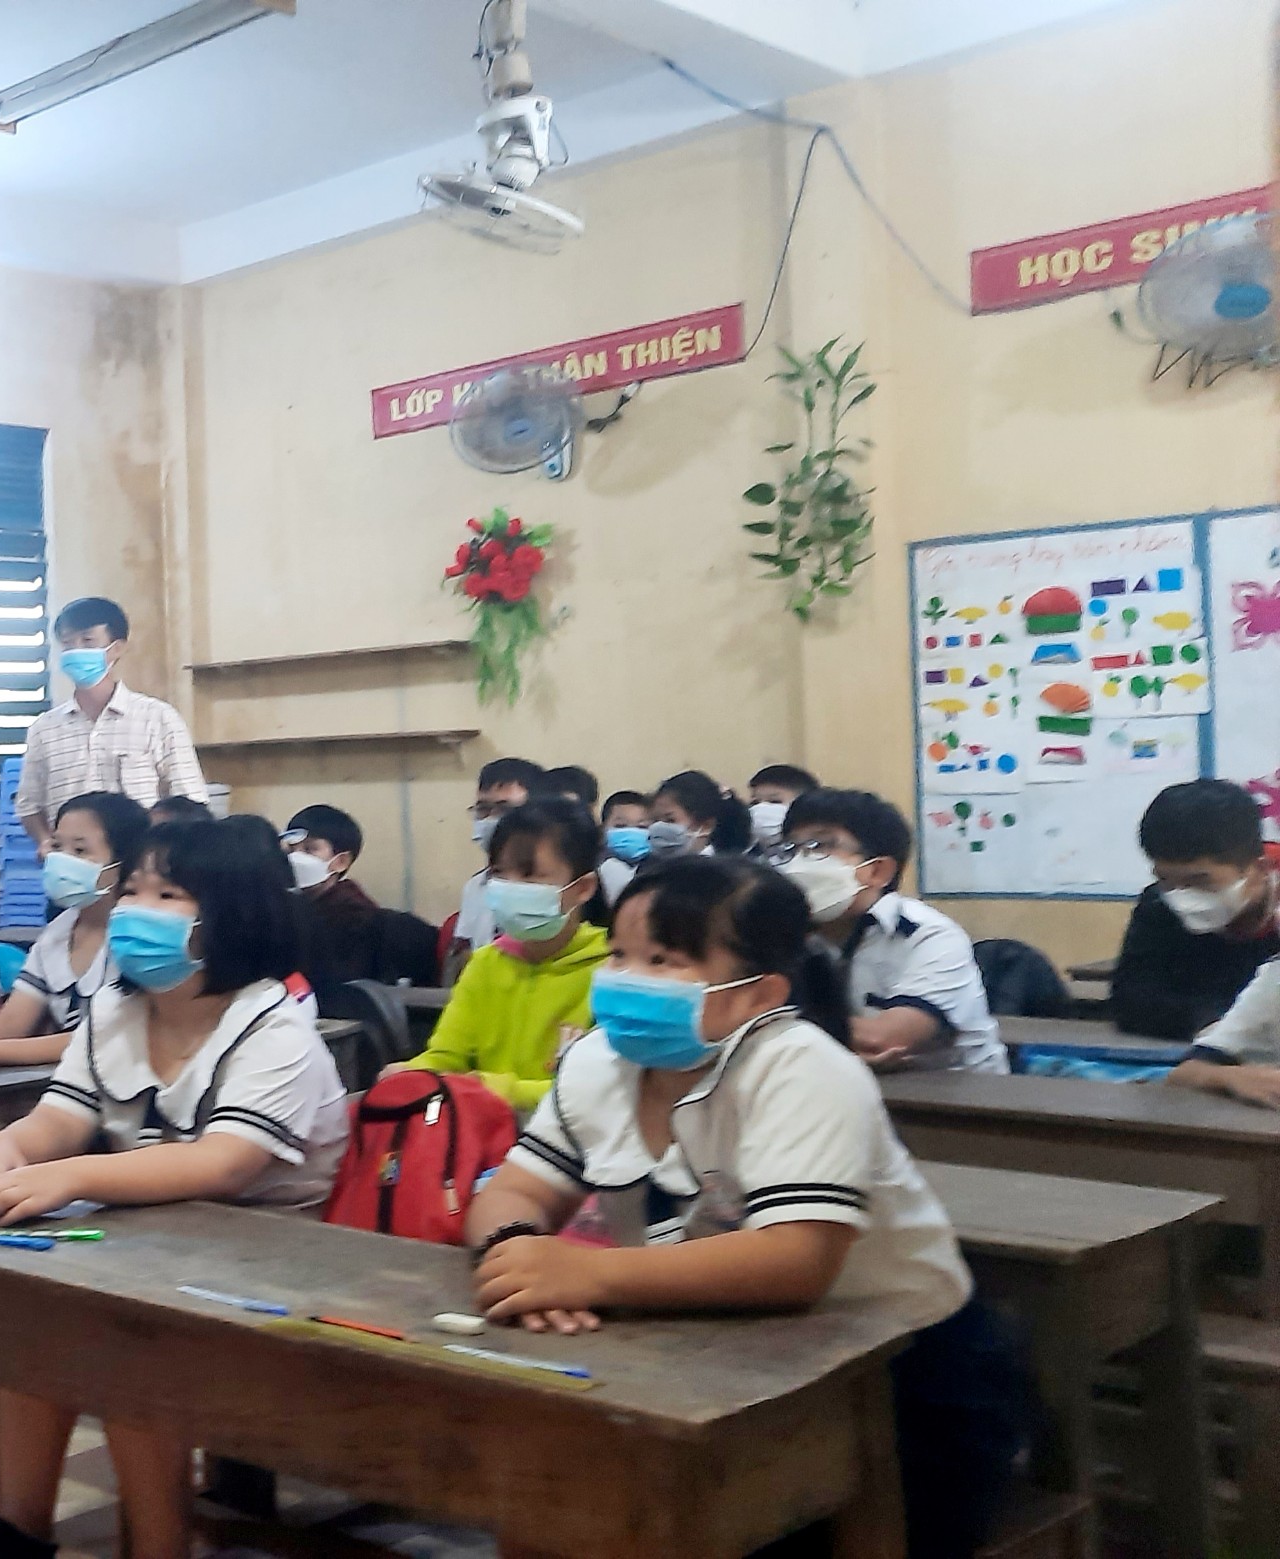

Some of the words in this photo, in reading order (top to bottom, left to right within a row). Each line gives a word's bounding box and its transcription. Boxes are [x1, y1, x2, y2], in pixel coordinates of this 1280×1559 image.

[1018, 240, 1114, 287] HỌC
[1129, 206, 1258, 264] SI
[389, 386, 444, 421] LỚP
[617, 325, 722, 371] THIỆN
